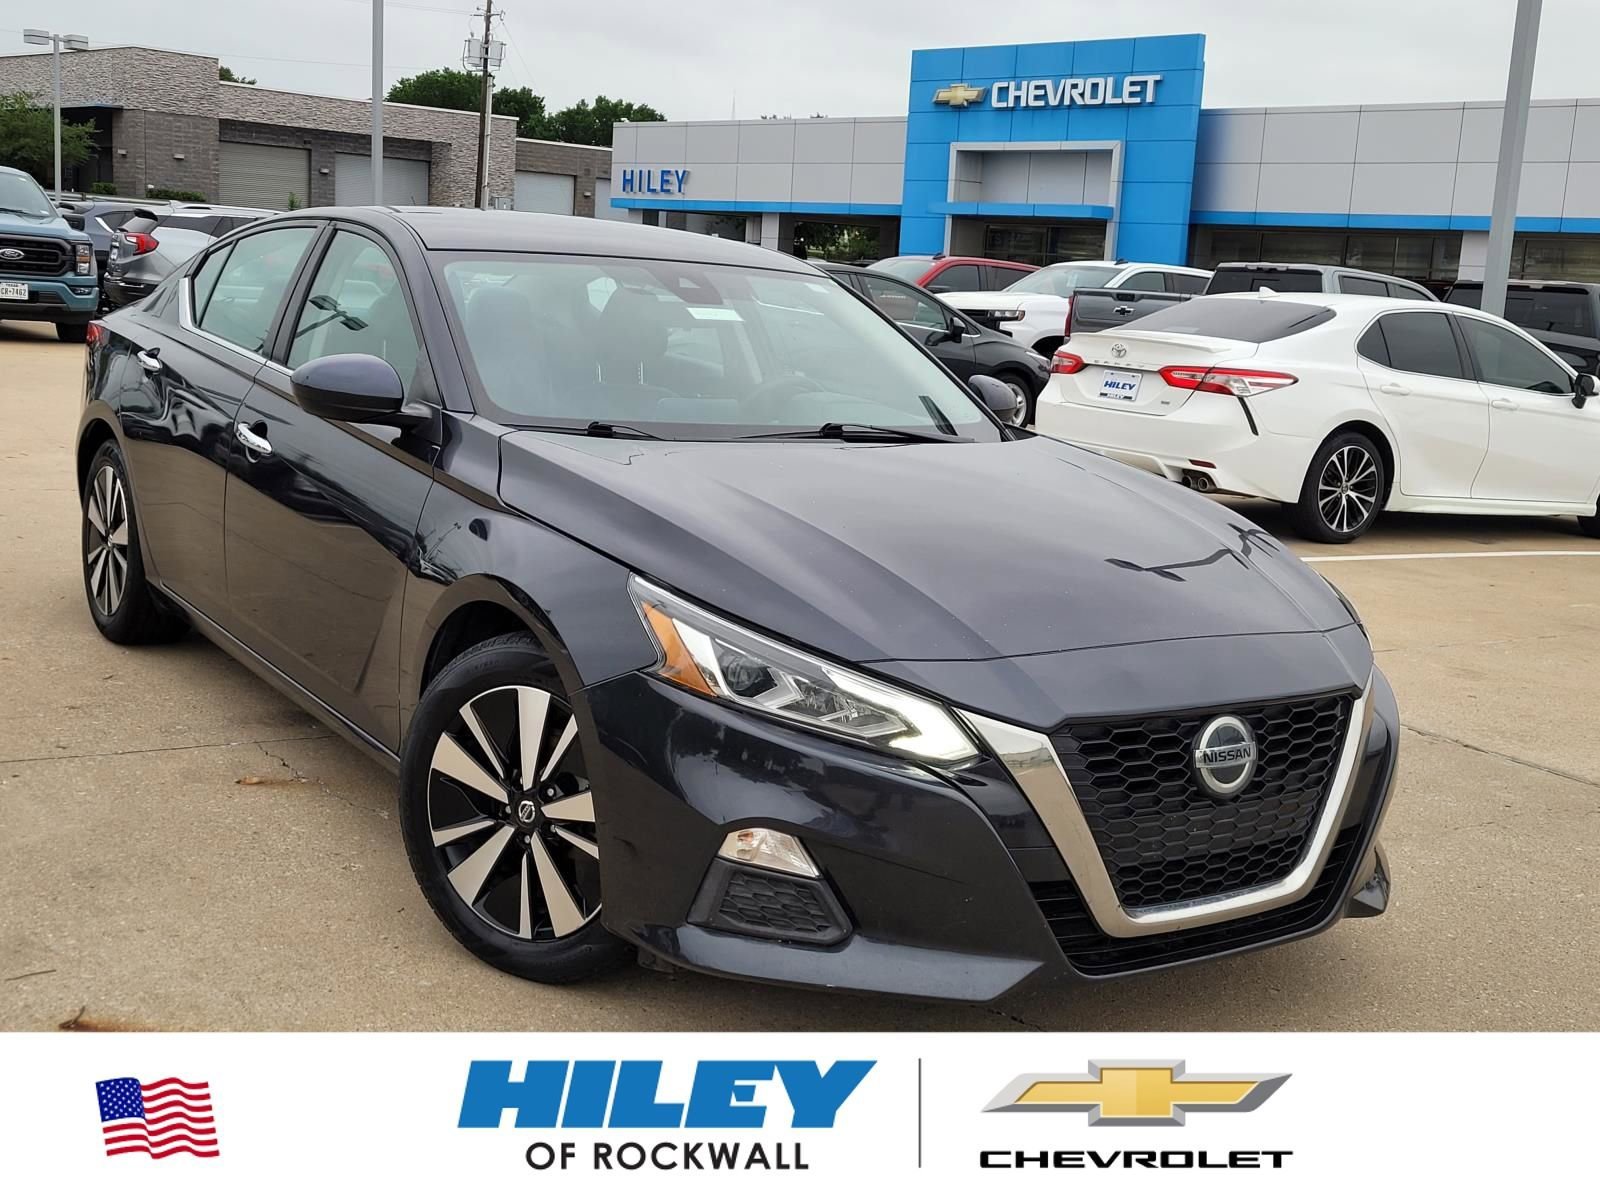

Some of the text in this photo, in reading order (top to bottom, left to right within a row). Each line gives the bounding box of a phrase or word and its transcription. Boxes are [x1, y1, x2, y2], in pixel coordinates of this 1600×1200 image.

[991, 74, 1163, 108] CHEVROLET
[622, 169, 687, 193] HILEY
[1103, 380, 1136, 391] HILEY
[1203, 746, 1251, 763] NISSAN
